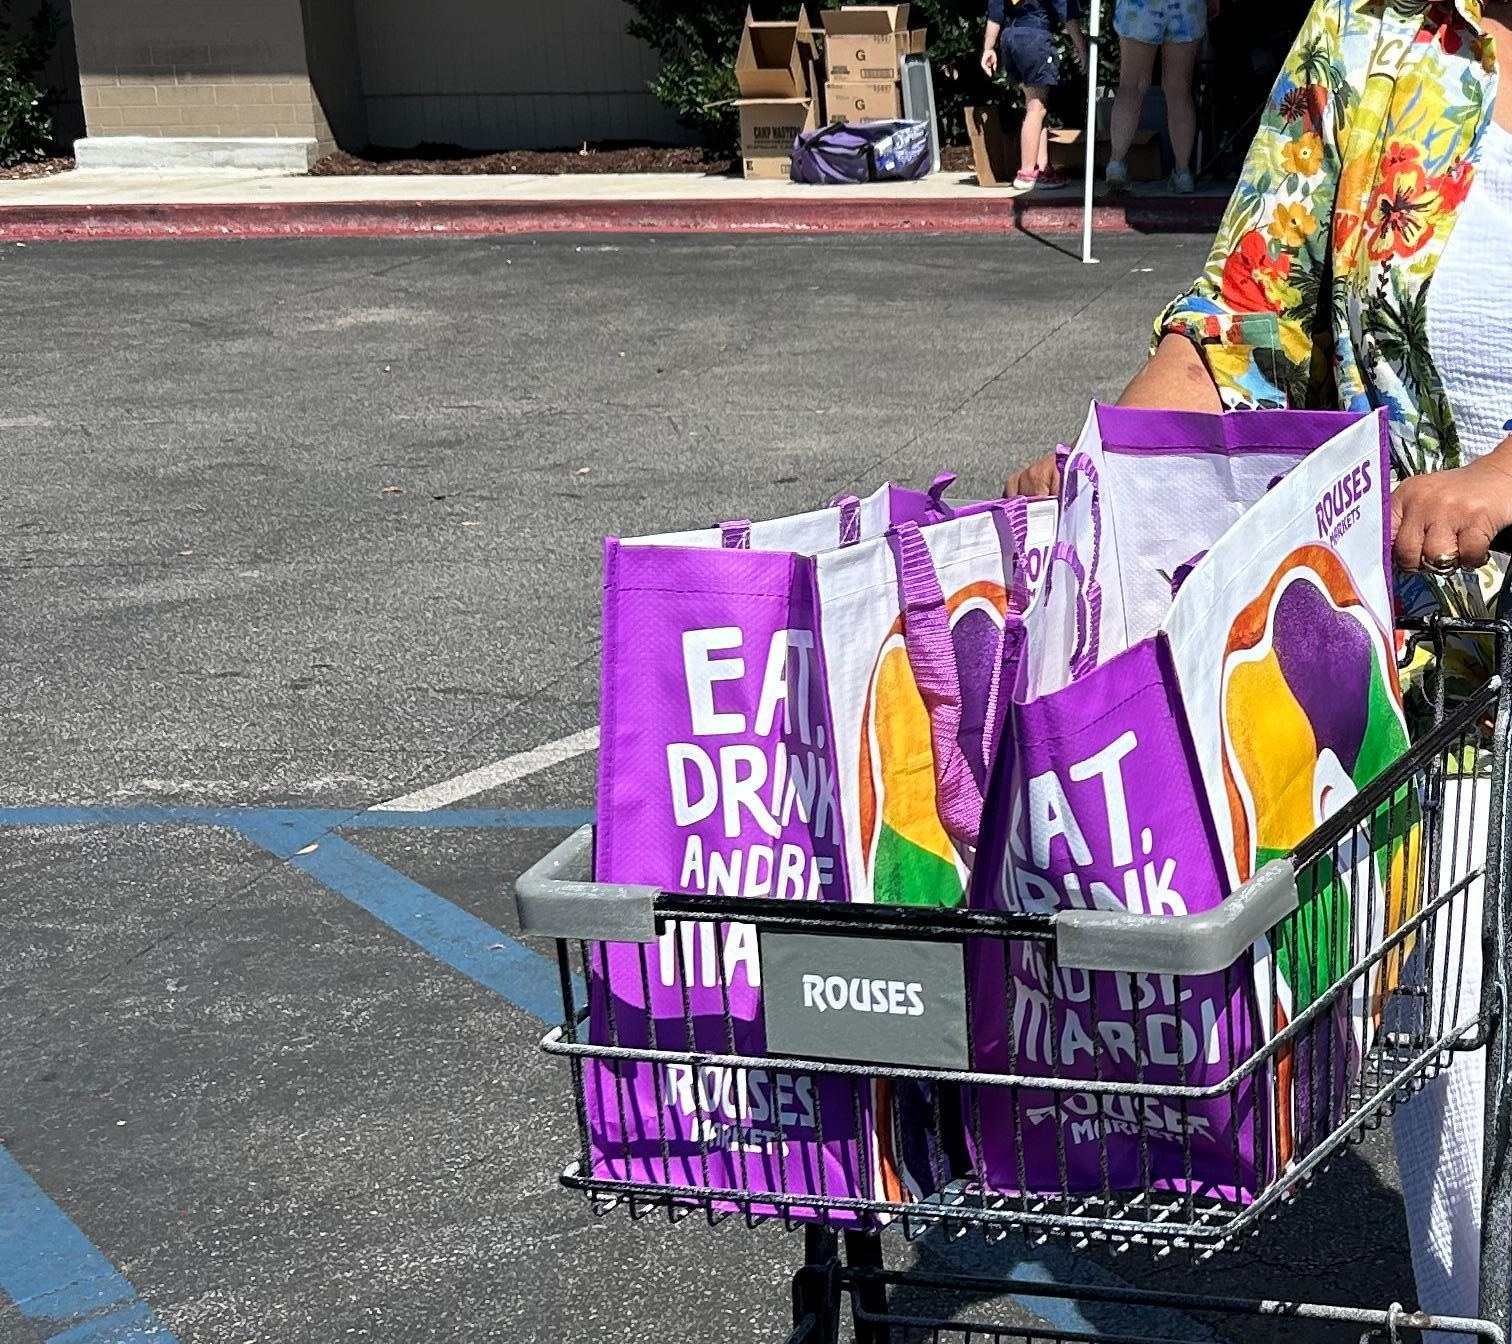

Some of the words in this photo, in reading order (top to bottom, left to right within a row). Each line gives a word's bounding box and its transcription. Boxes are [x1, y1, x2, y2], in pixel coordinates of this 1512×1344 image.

[855, 49, 866, 61] G
[855, 99, 866, 111] G
[1315, 459, 1372, 540] ROUSES
[1329, 504, 1361, 549] MARKETS
[681, 626, 825, 749] EAT.
[666, 741, 841, 846] DRINK
[802, 973, 925, 1016] ROUSES
[1012, 975, 1221, 1067] MARDI
